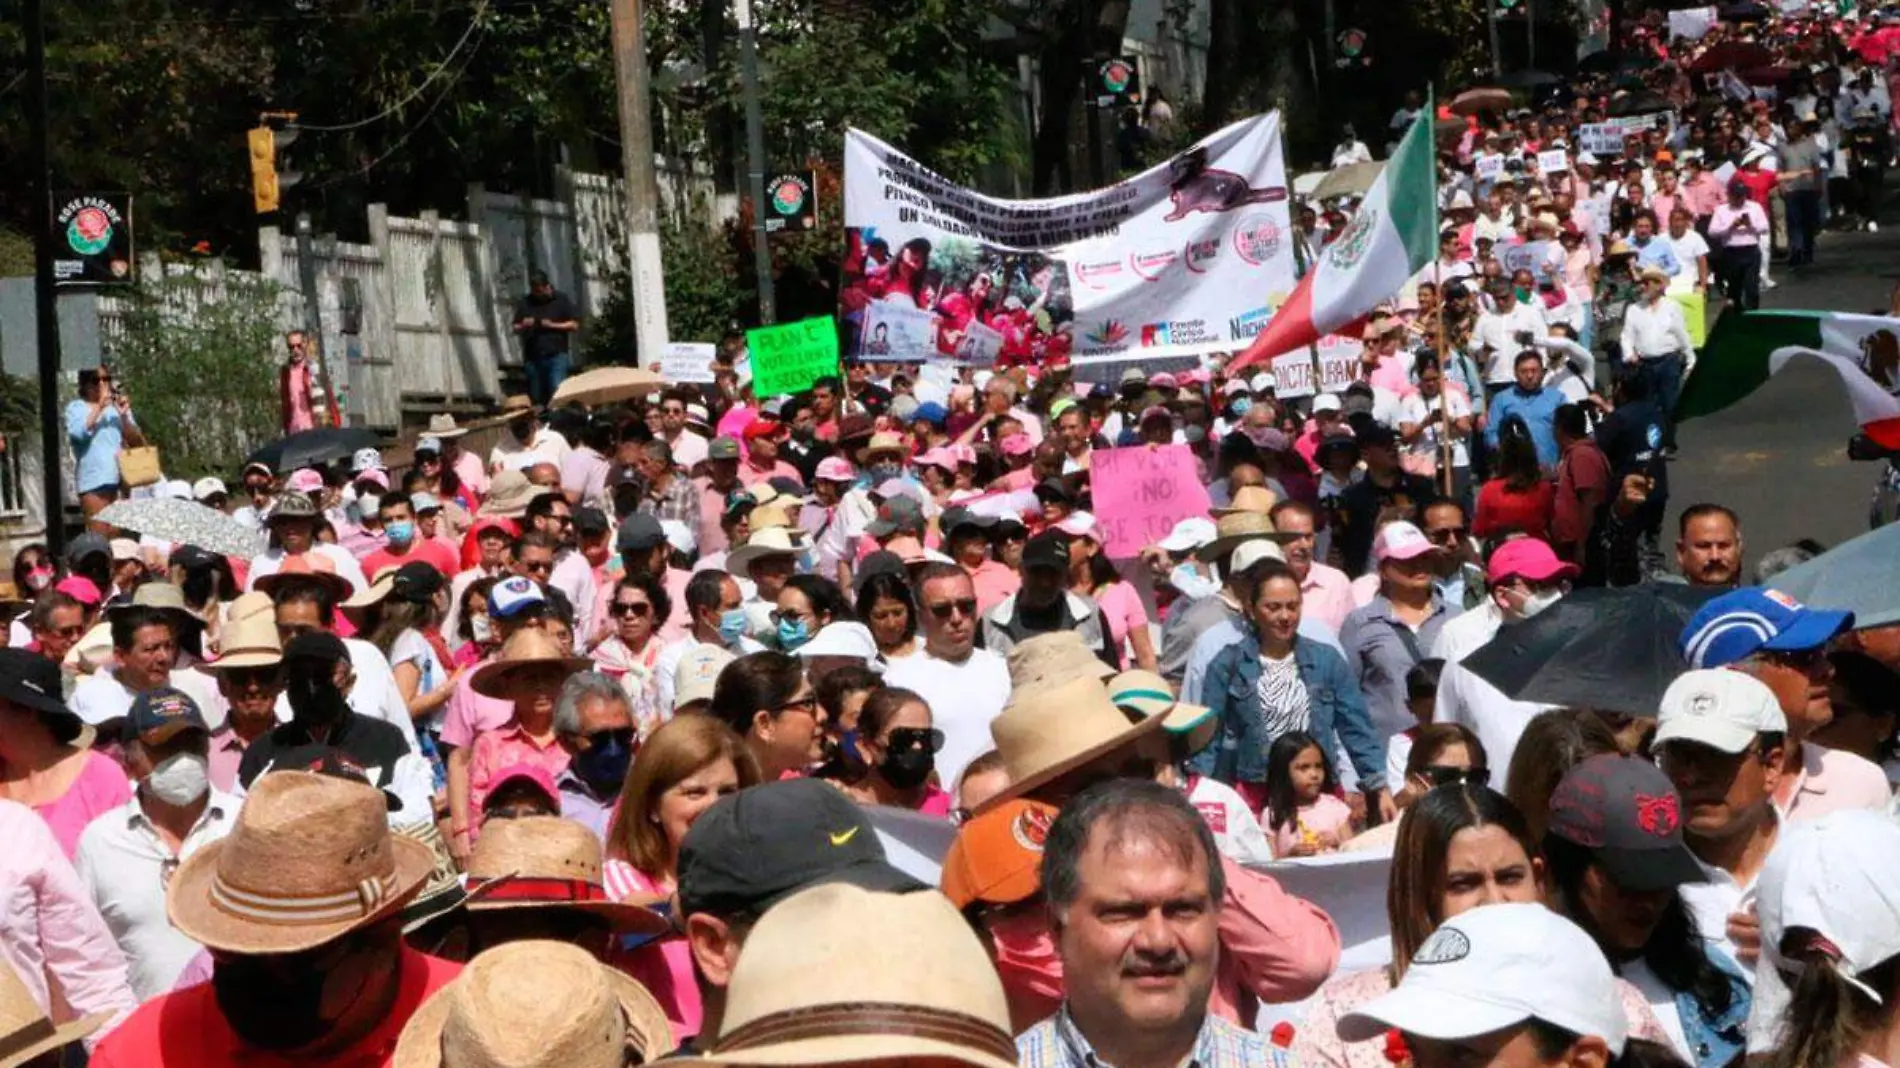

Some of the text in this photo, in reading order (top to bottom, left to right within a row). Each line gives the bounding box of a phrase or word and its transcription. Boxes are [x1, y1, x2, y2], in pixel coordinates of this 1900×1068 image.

[58, 196, 121, 224] ROSE PARADE
[899, 206, 919, 222] UN
[758, 330, 803, 353] PLAN
